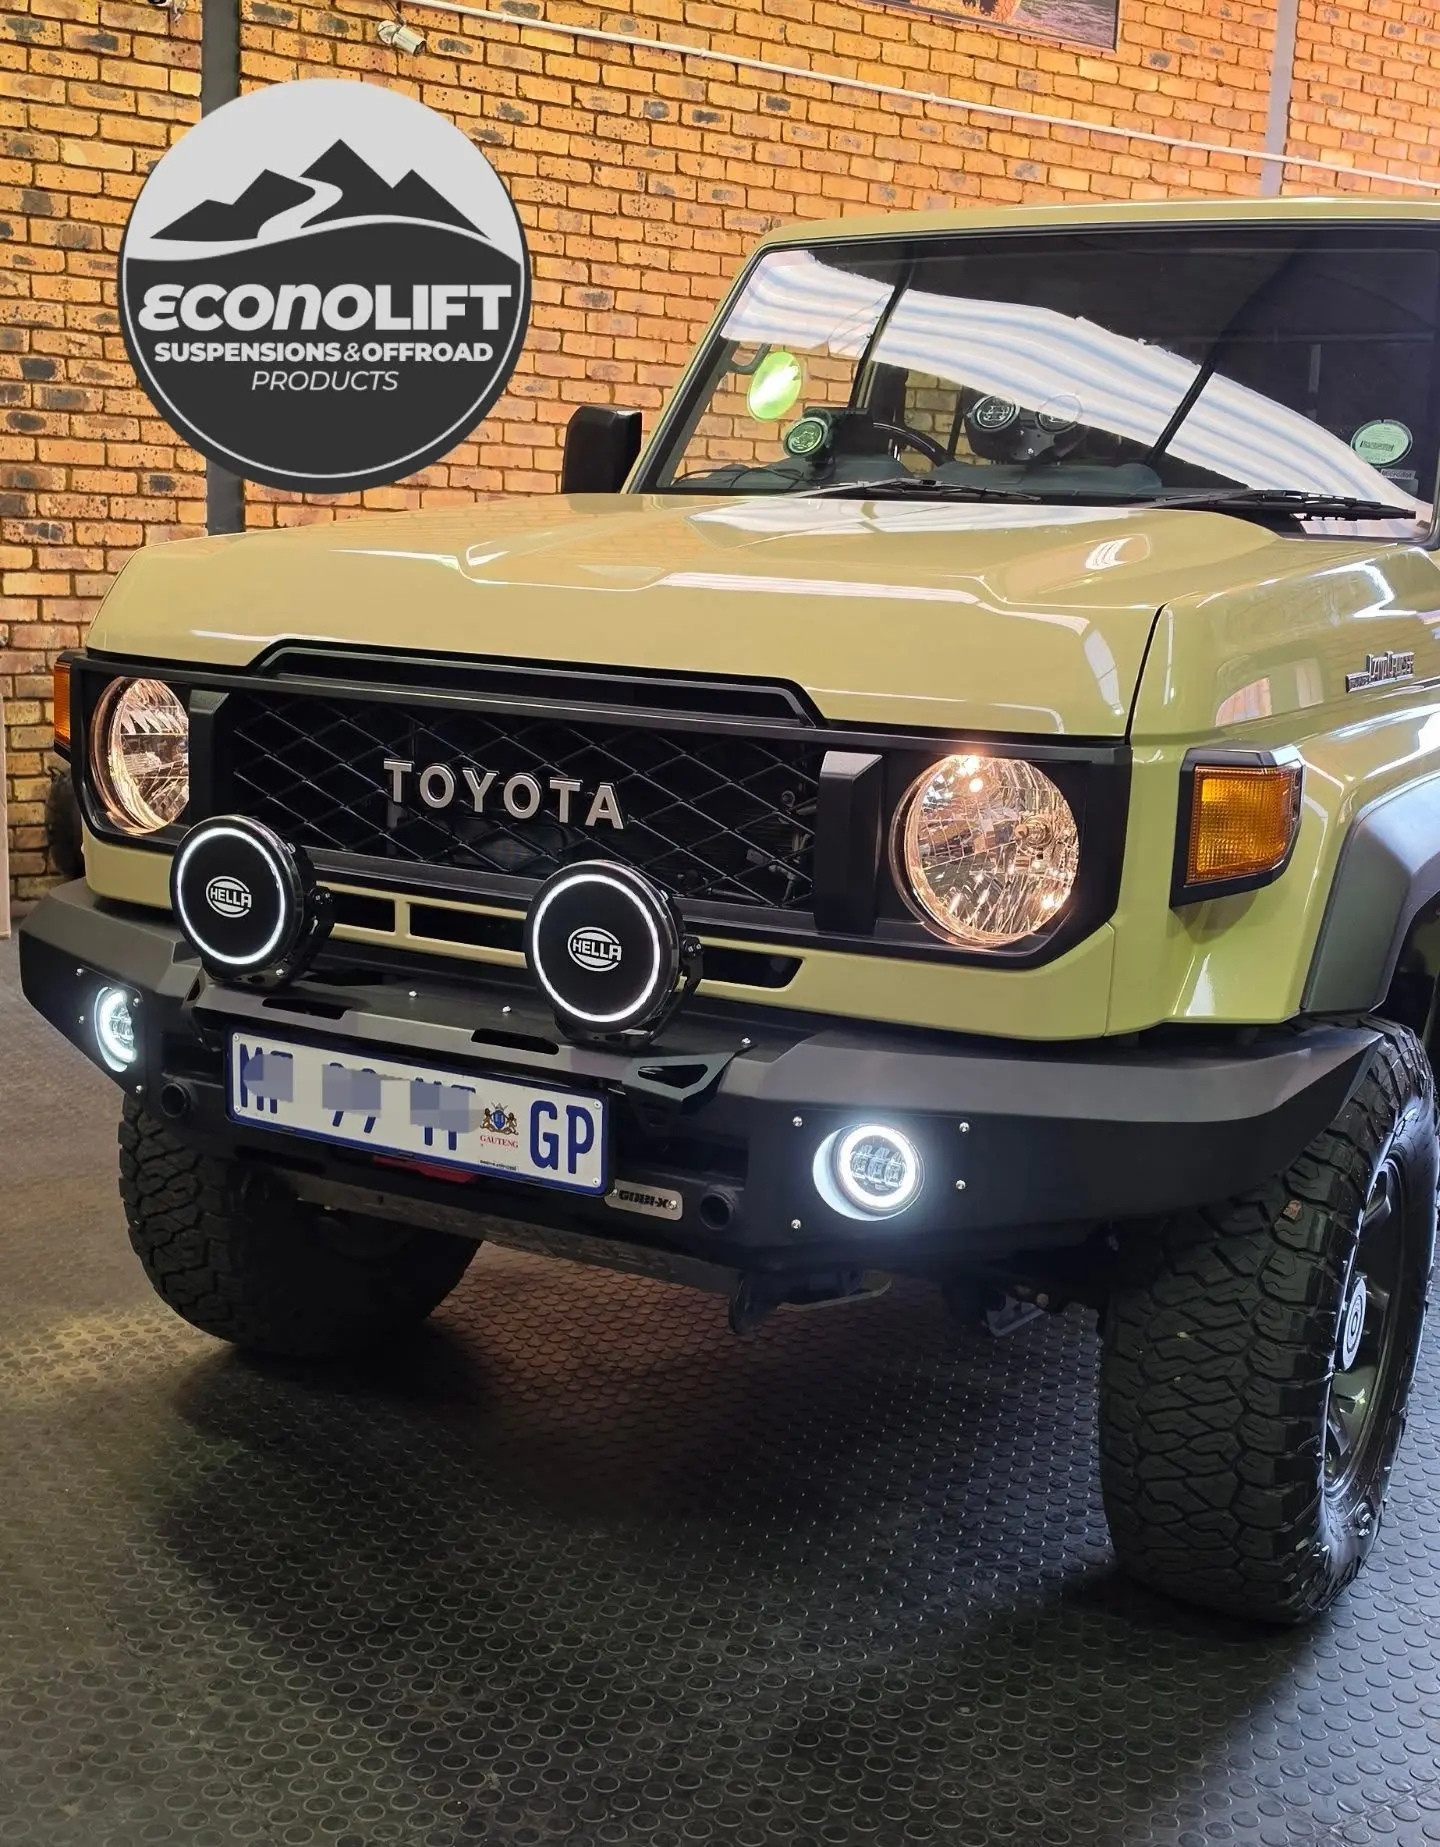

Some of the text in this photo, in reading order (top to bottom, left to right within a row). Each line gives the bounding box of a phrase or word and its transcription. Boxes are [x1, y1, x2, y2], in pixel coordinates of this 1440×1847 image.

[383, 758, 625, 830] TOYOTA
[210, 887, 252, 908] HELLA
[572, 938, 622, 961] HELLA
[480, 1135, 519, 1148] GAUTENG
[529, 1100, 595, 1175] GP
